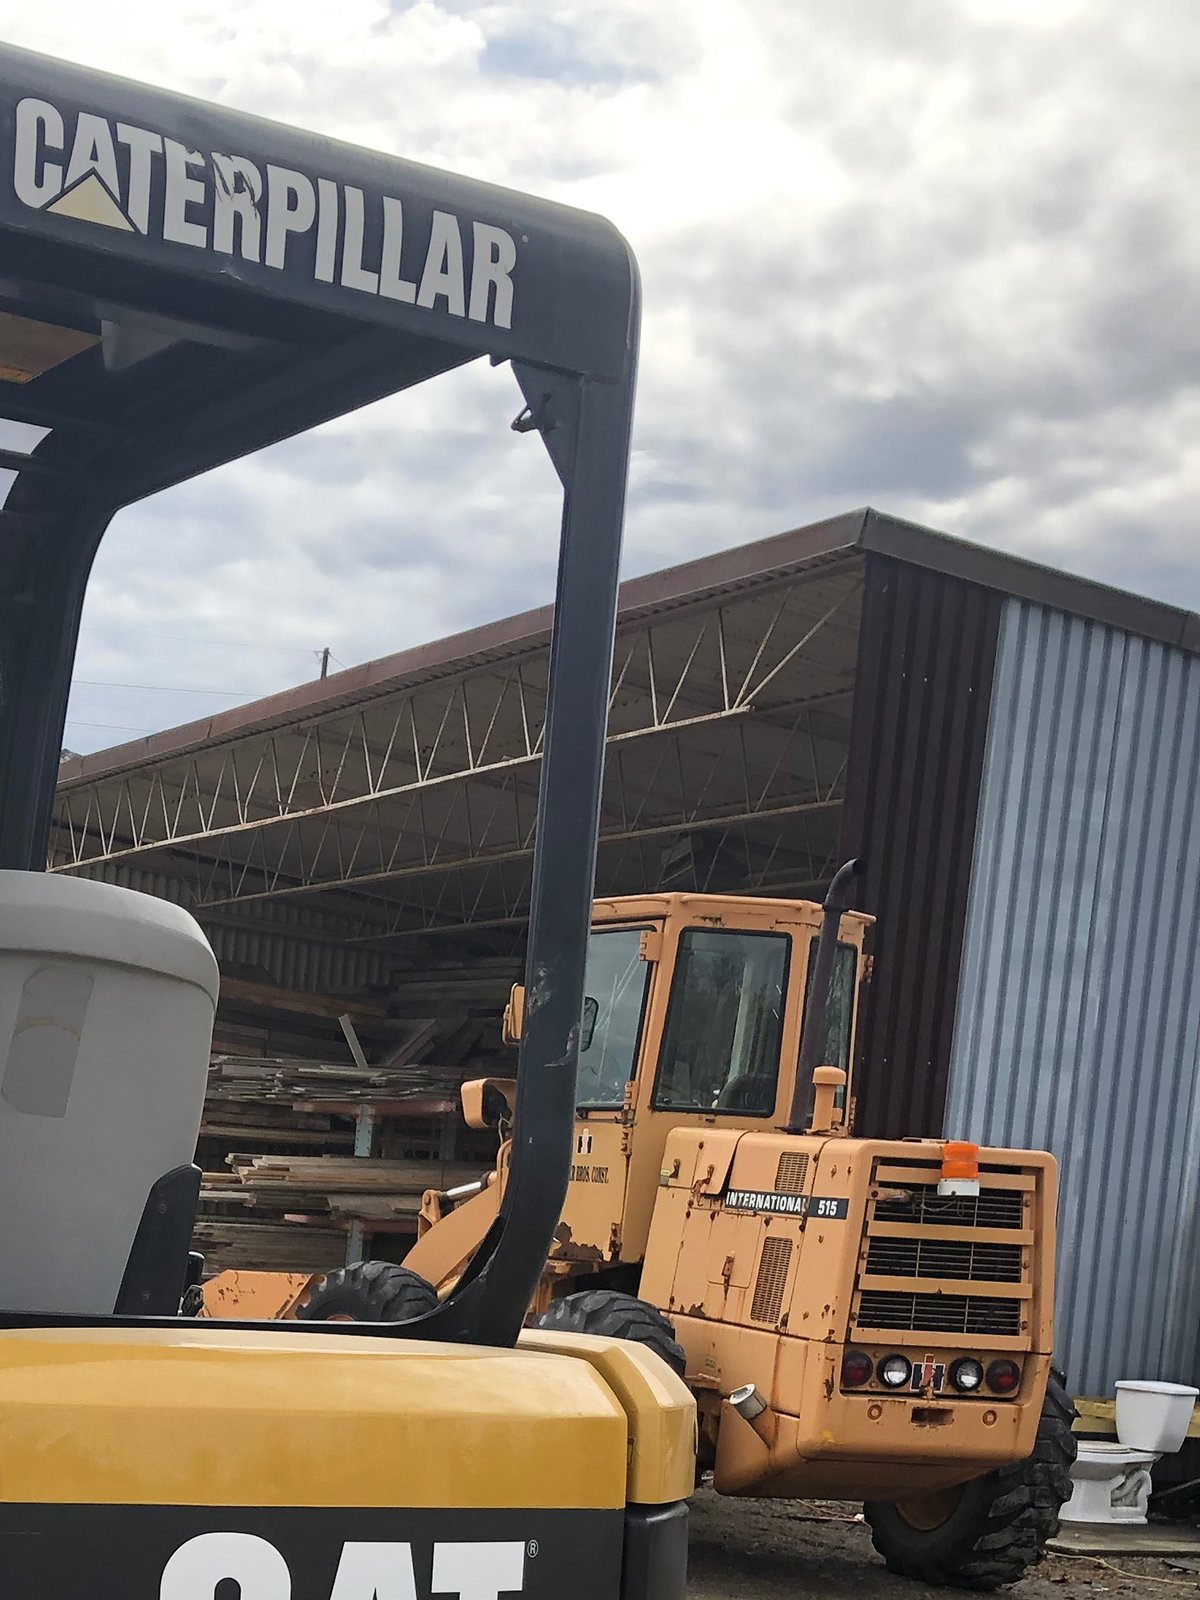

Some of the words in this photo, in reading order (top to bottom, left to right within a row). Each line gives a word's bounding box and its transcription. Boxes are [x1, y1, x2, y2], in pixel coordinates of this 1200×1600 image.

[13, 97, 517, 330] CATERPILLAR
[725, 1191, 807, 1212] INTERNATIONAL
[817, 1200, 838, 1216] 515
